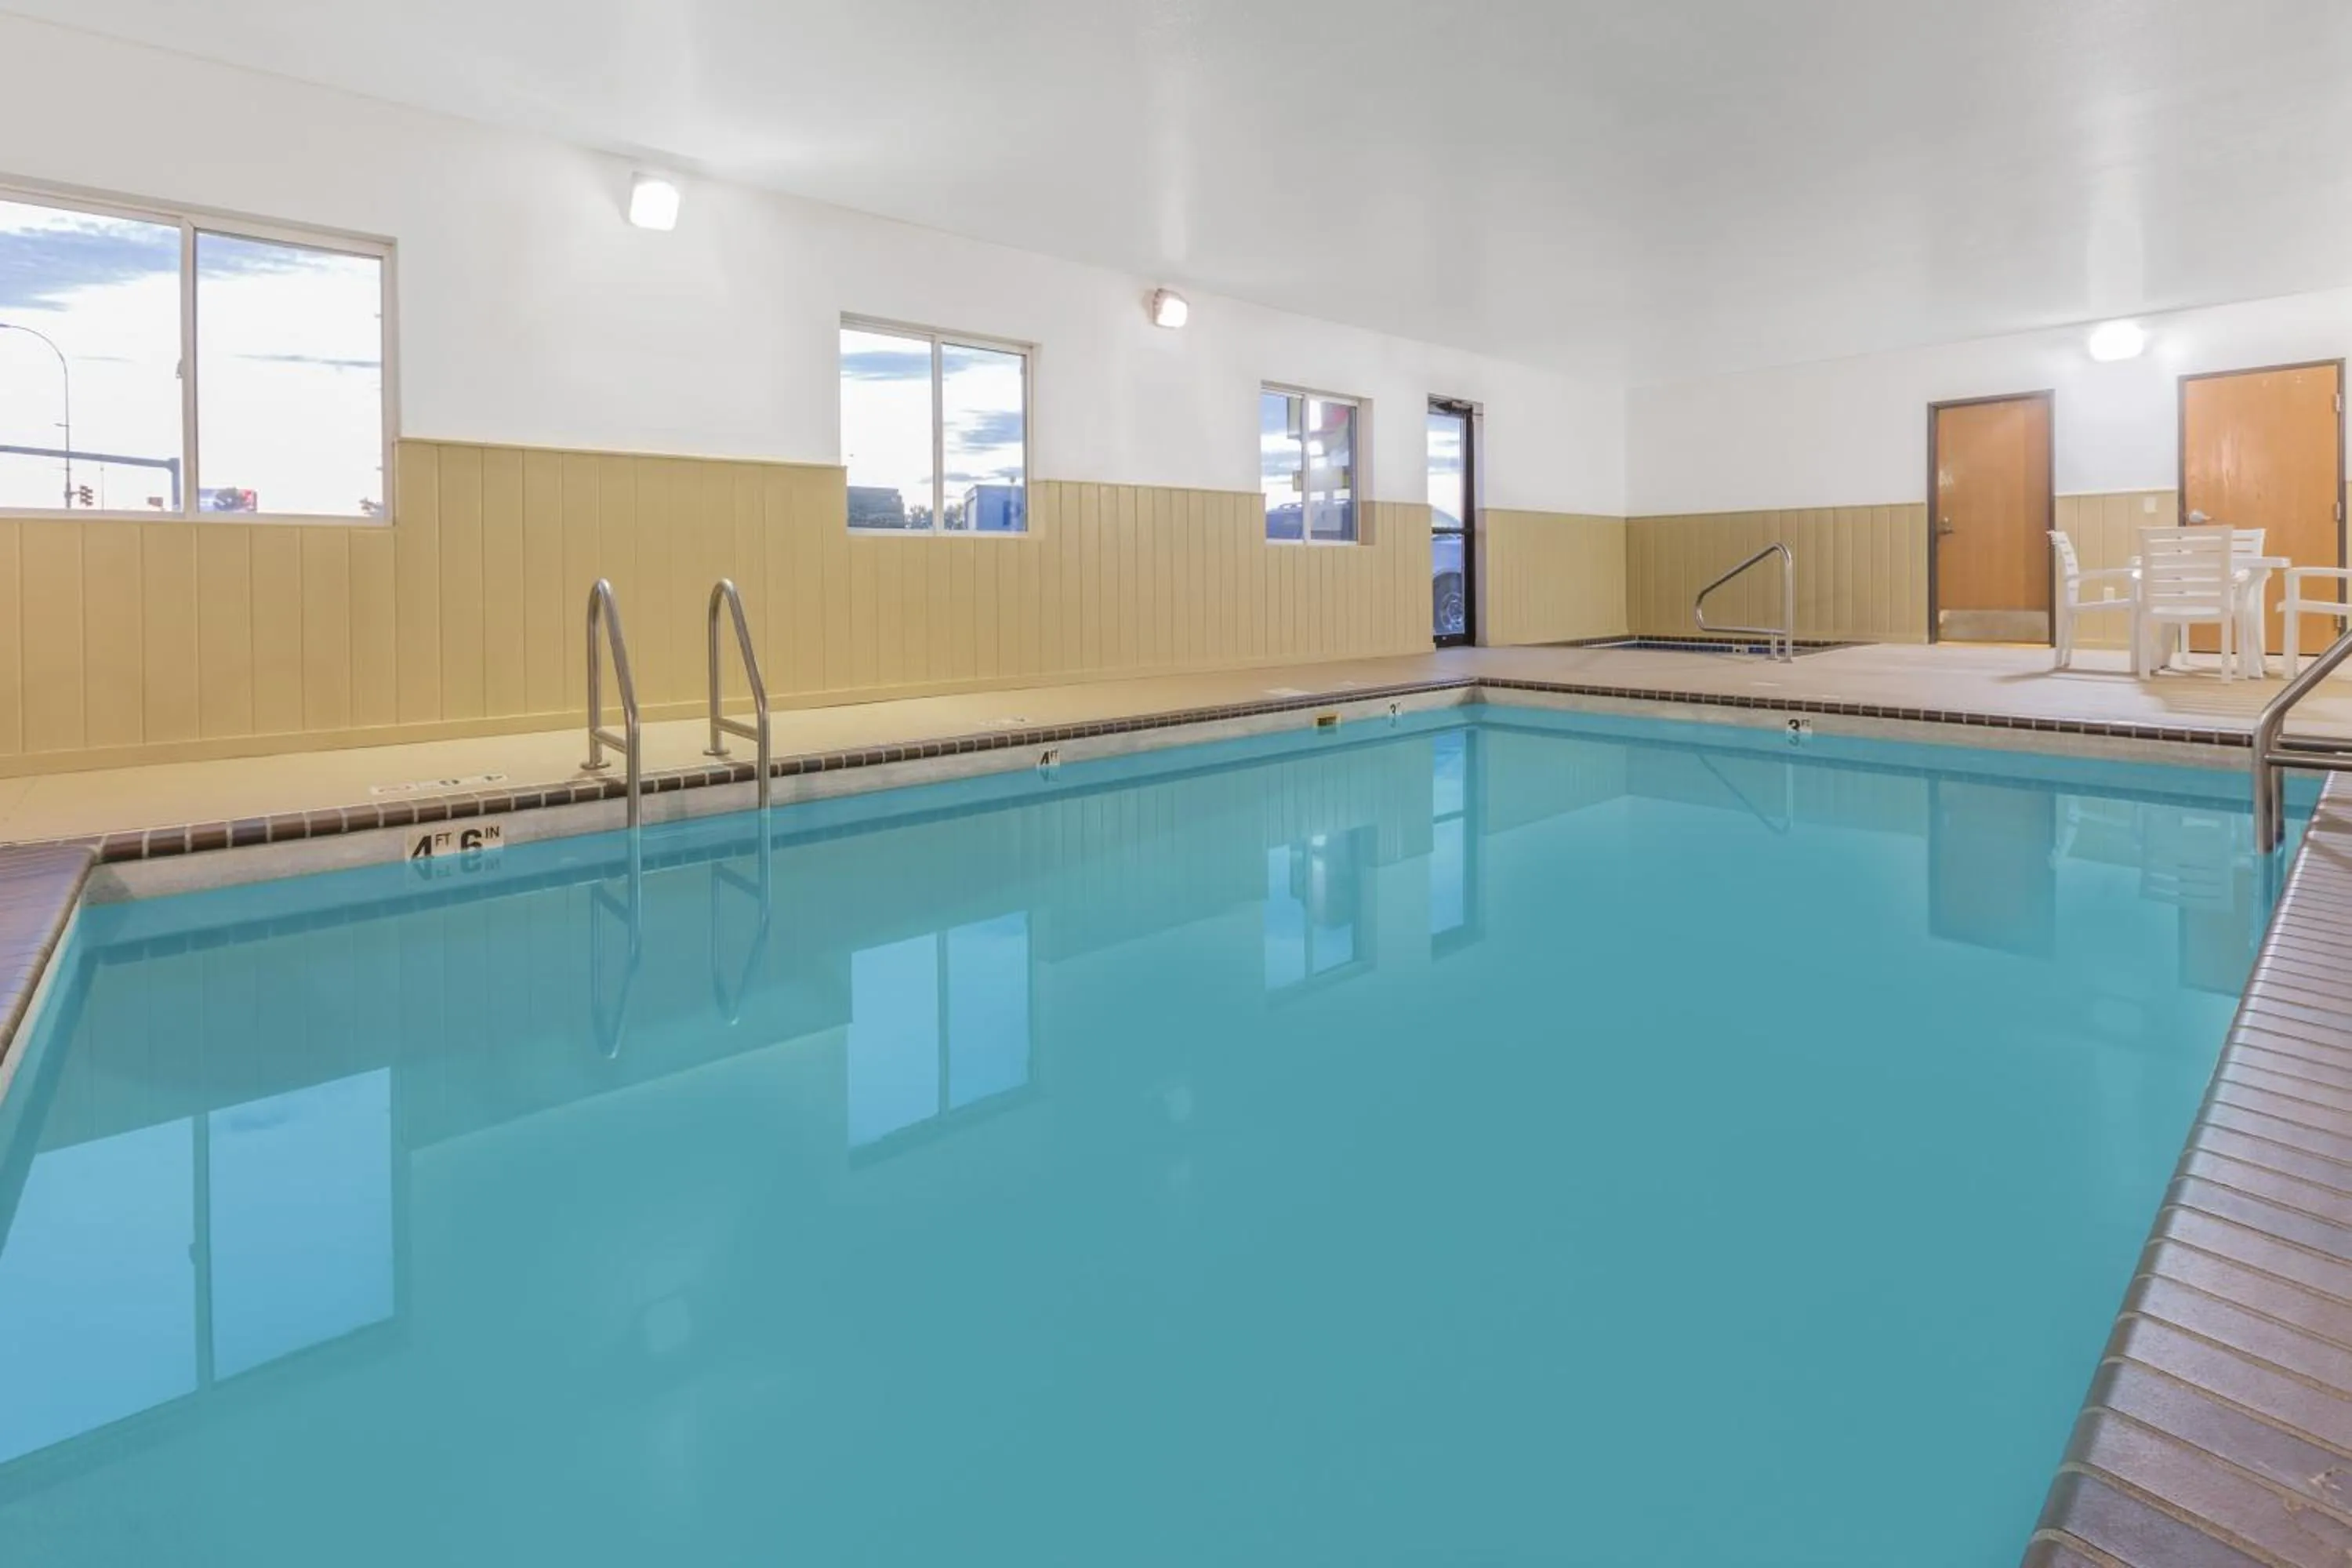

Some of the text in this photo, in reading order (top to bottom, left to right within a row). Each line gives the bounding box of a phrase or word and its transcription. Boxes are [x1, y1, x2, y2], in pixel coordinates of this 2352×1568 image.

[1788, 719, 1800, 731] 3
[1040, 751, 1049, 765] 4
[412, 826, 500, 859] 4 FT 6 IN
